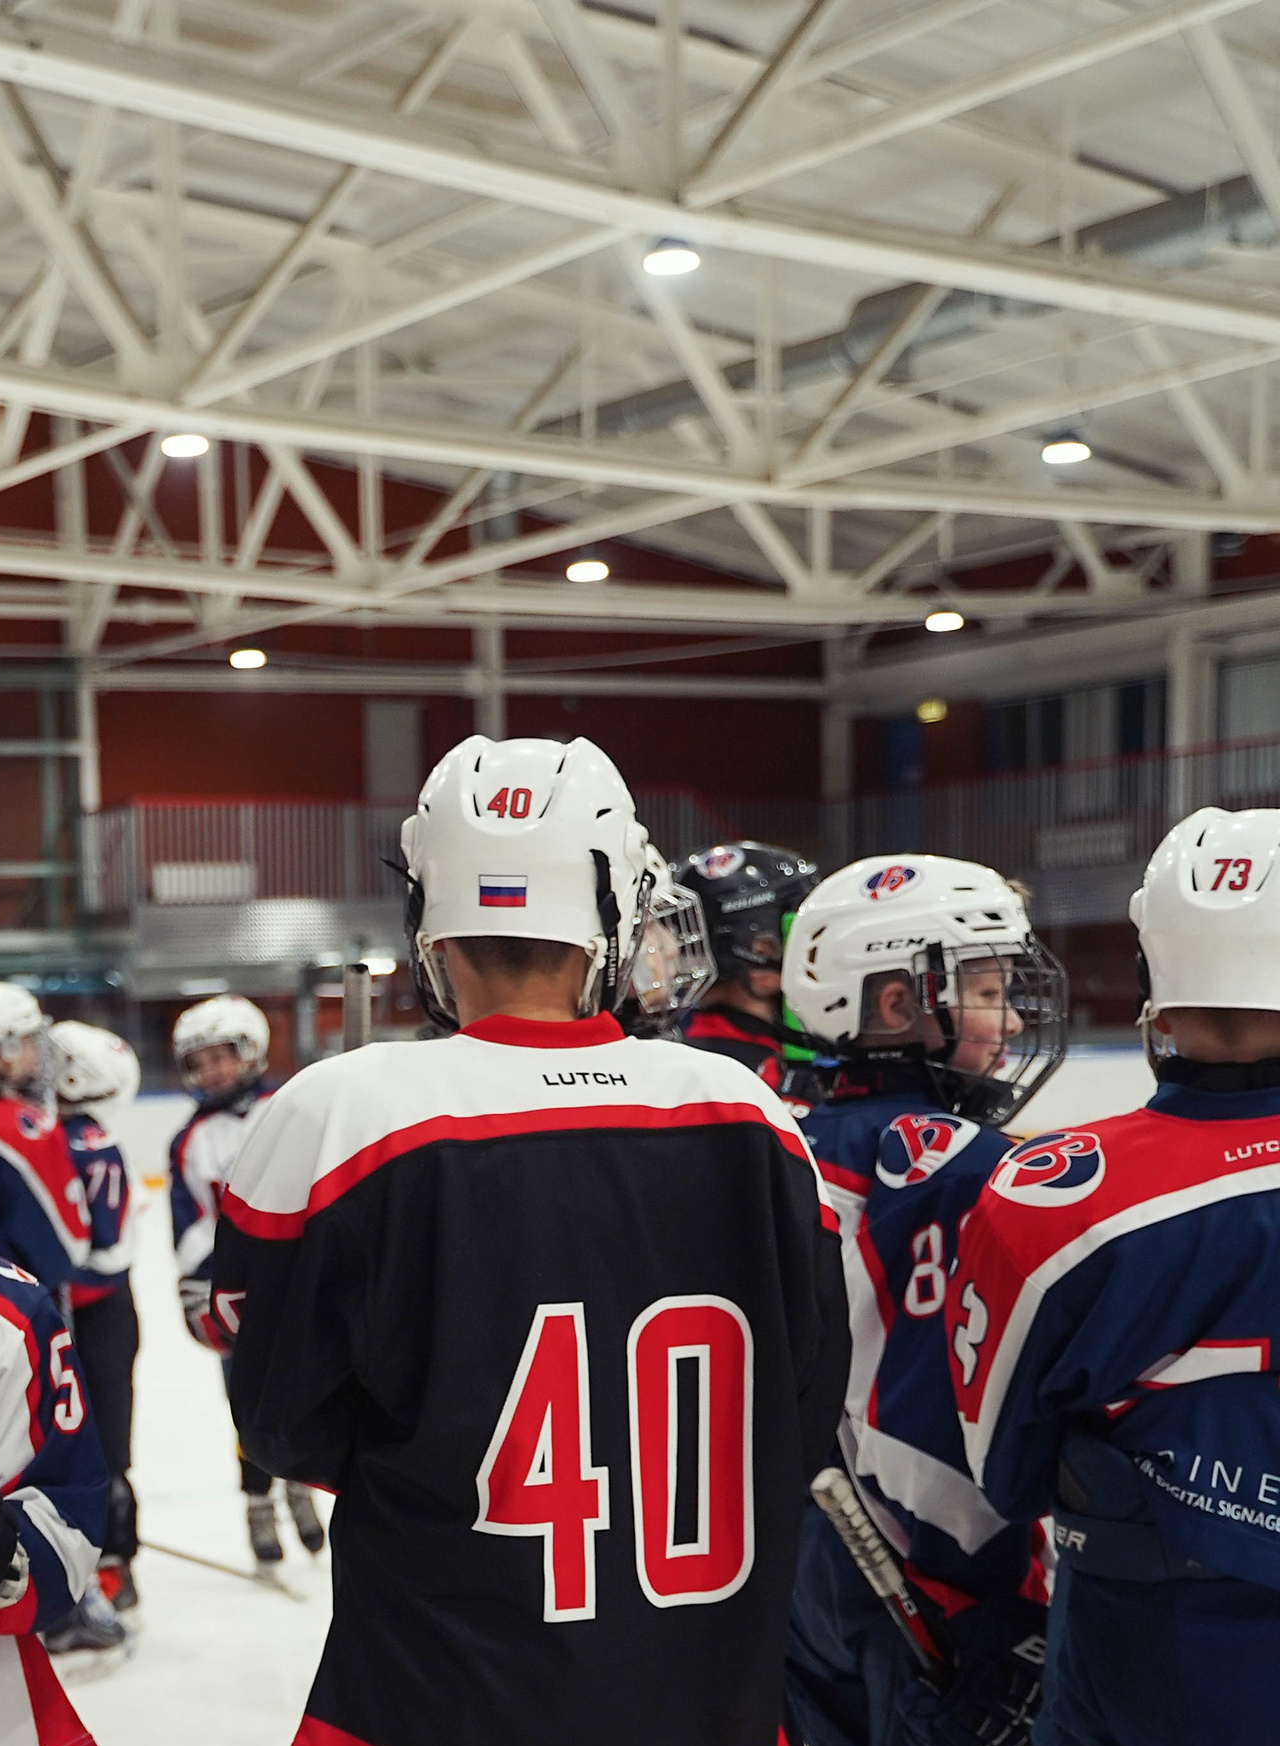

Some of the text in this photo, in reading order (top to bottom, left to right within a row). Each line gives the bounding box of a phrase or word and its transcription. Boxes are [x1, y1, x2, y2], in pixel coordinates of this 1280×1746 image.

[487, 787, 532, 819] 40
[1211, 858, 1253, 891] 73
[867, 937, 925, 952] CCM
[606, 936, 617, 987] BAUER
[542, 1072, 628, 1086] LUTCH
[1224, 1139, 1280, 1163] LUTC
[471, 1294, 755, 1623] 40
